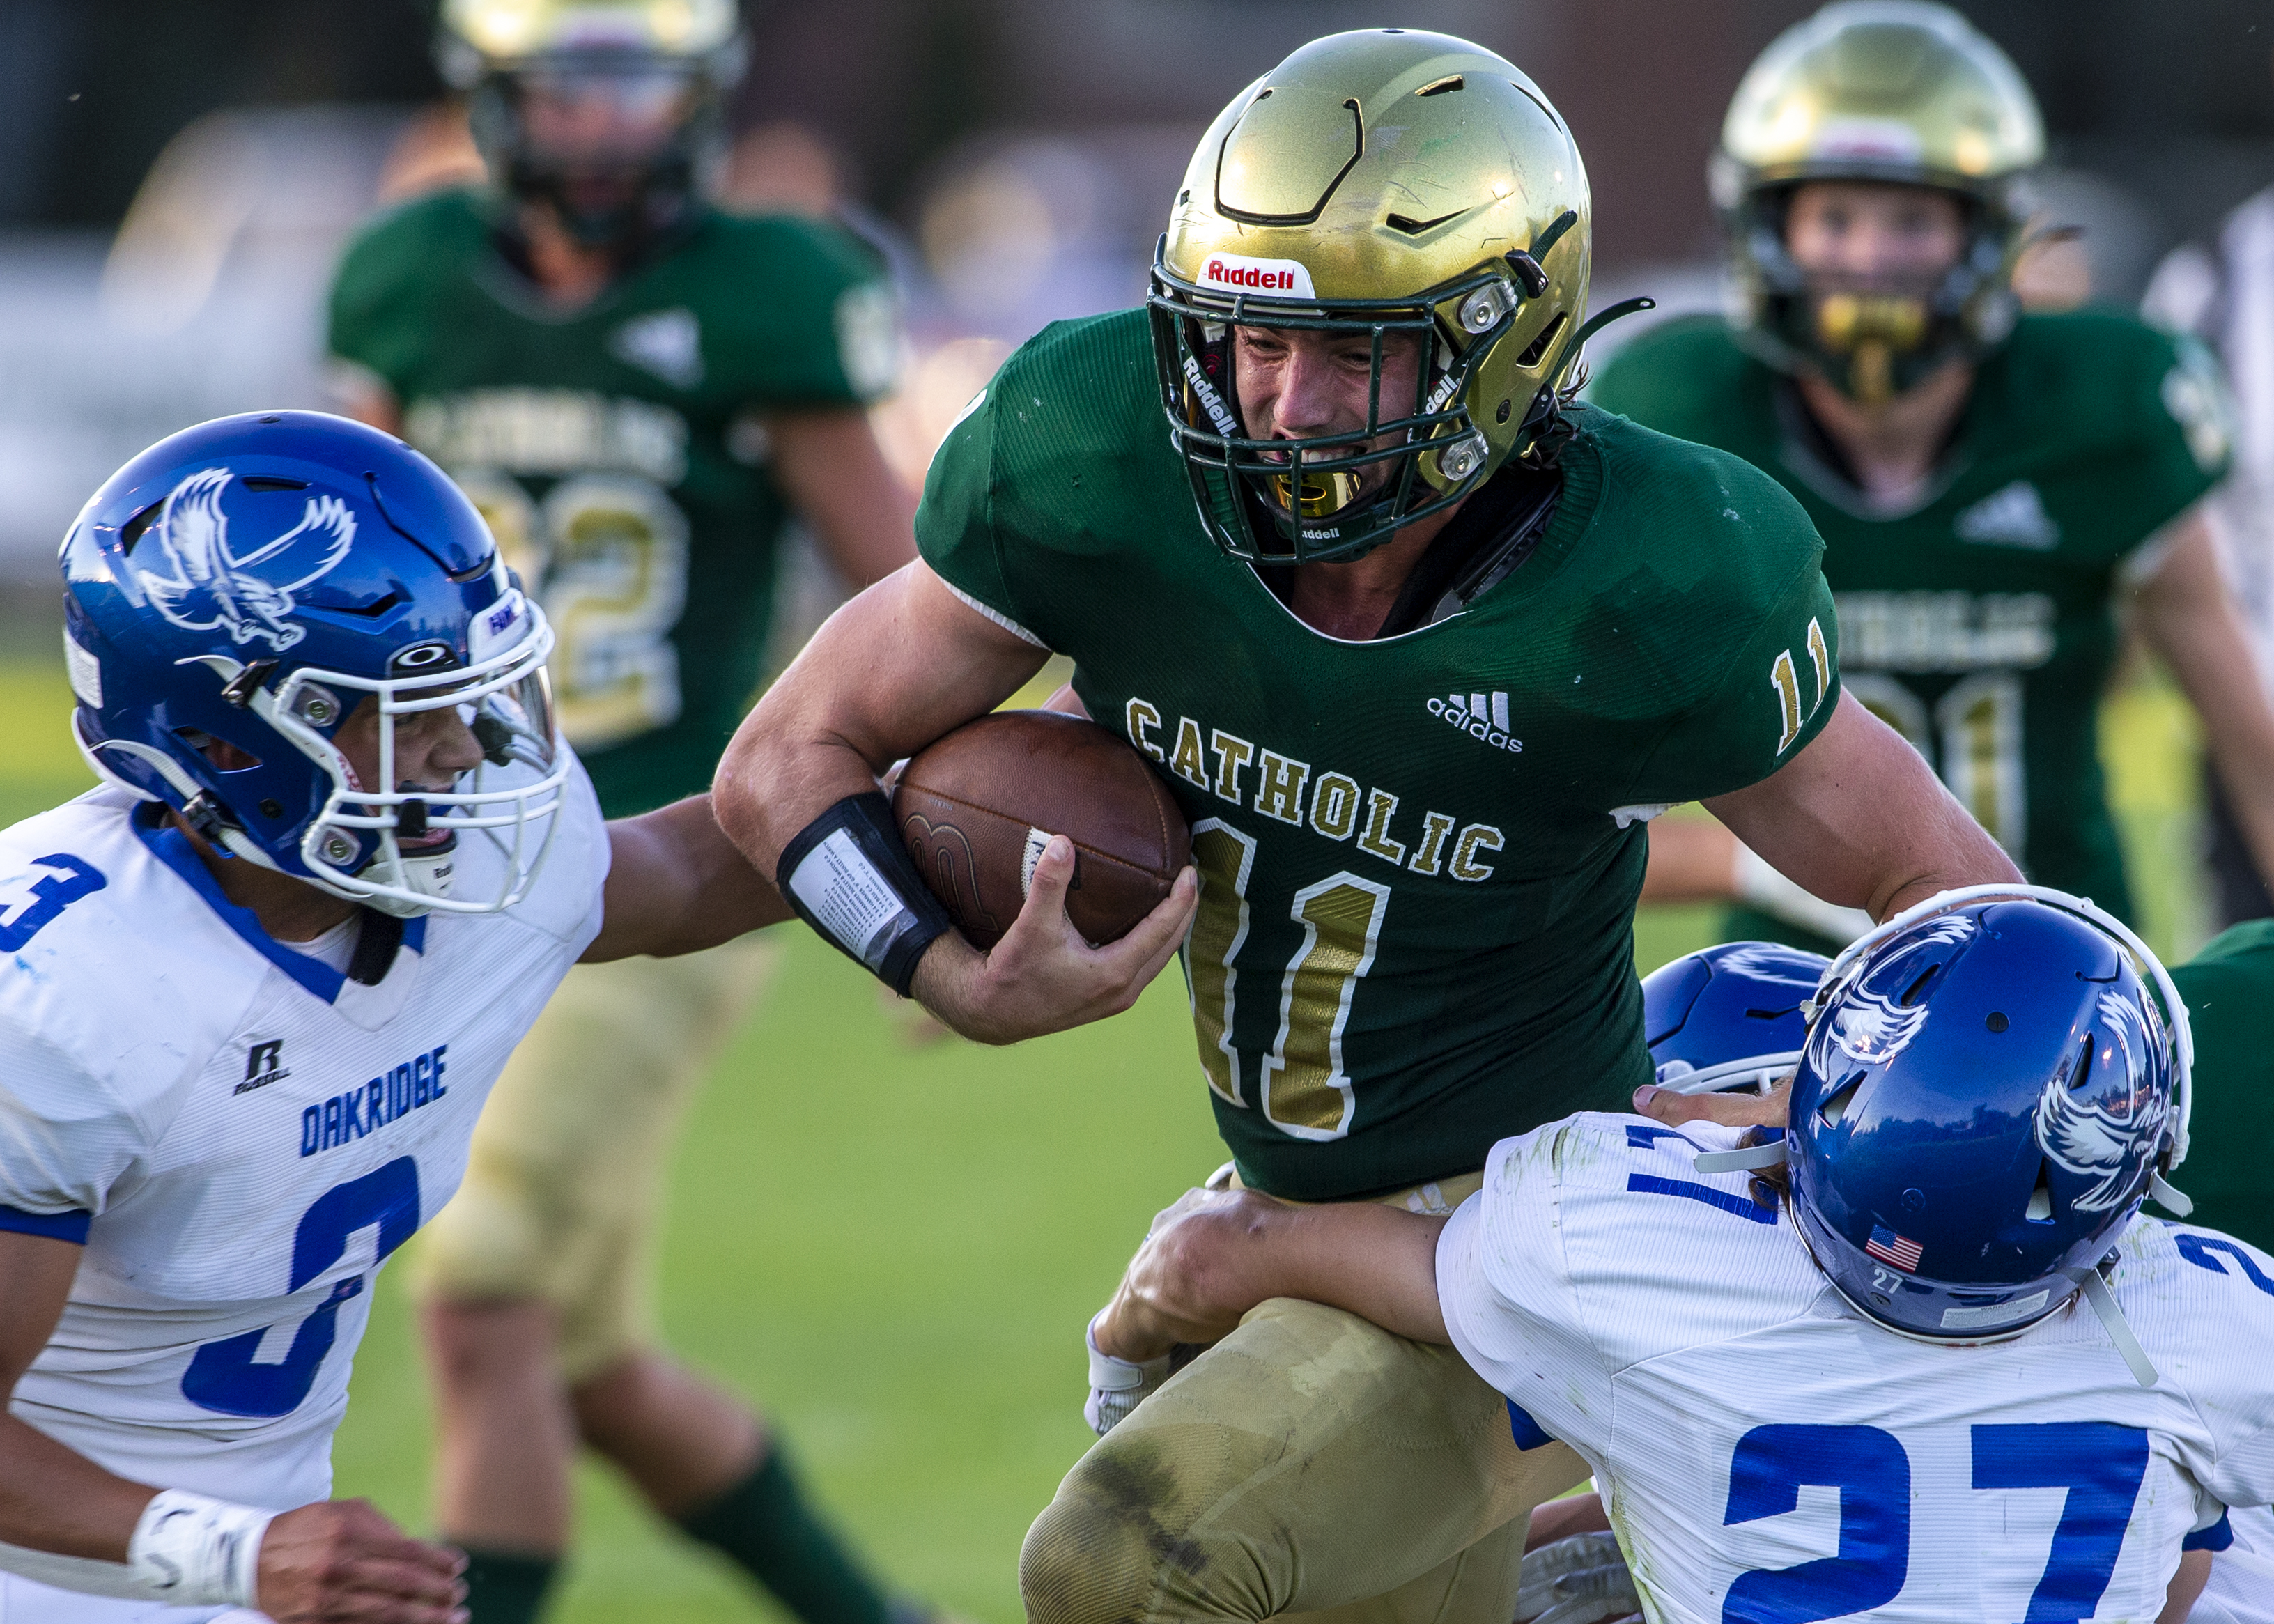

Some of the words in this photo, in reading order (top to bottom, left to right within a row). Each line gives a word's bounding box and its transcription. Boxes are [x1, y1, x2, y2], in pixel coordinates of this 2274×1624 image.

[1208, 260, 1294, 289] Riddell
[1183, 355, 1237, 435] Riddell
[1427, 697, 1524, 754] adidas
[1770, 615, 1830, 757] 11
[1126, 697, 1505, 883] CATHOLIC
[0, 854, 106, 952] 3
[1183, 816, 1392, 1143] 11
[245, 1039, 284, 1081] R
[301, 1044, 447, 1158] OAKRIDGE
[180, 1154, 420, 1418] 3
[1872, 1268, 1903, 1294] 27
[1722, 1421, 2151, 1624] 27
